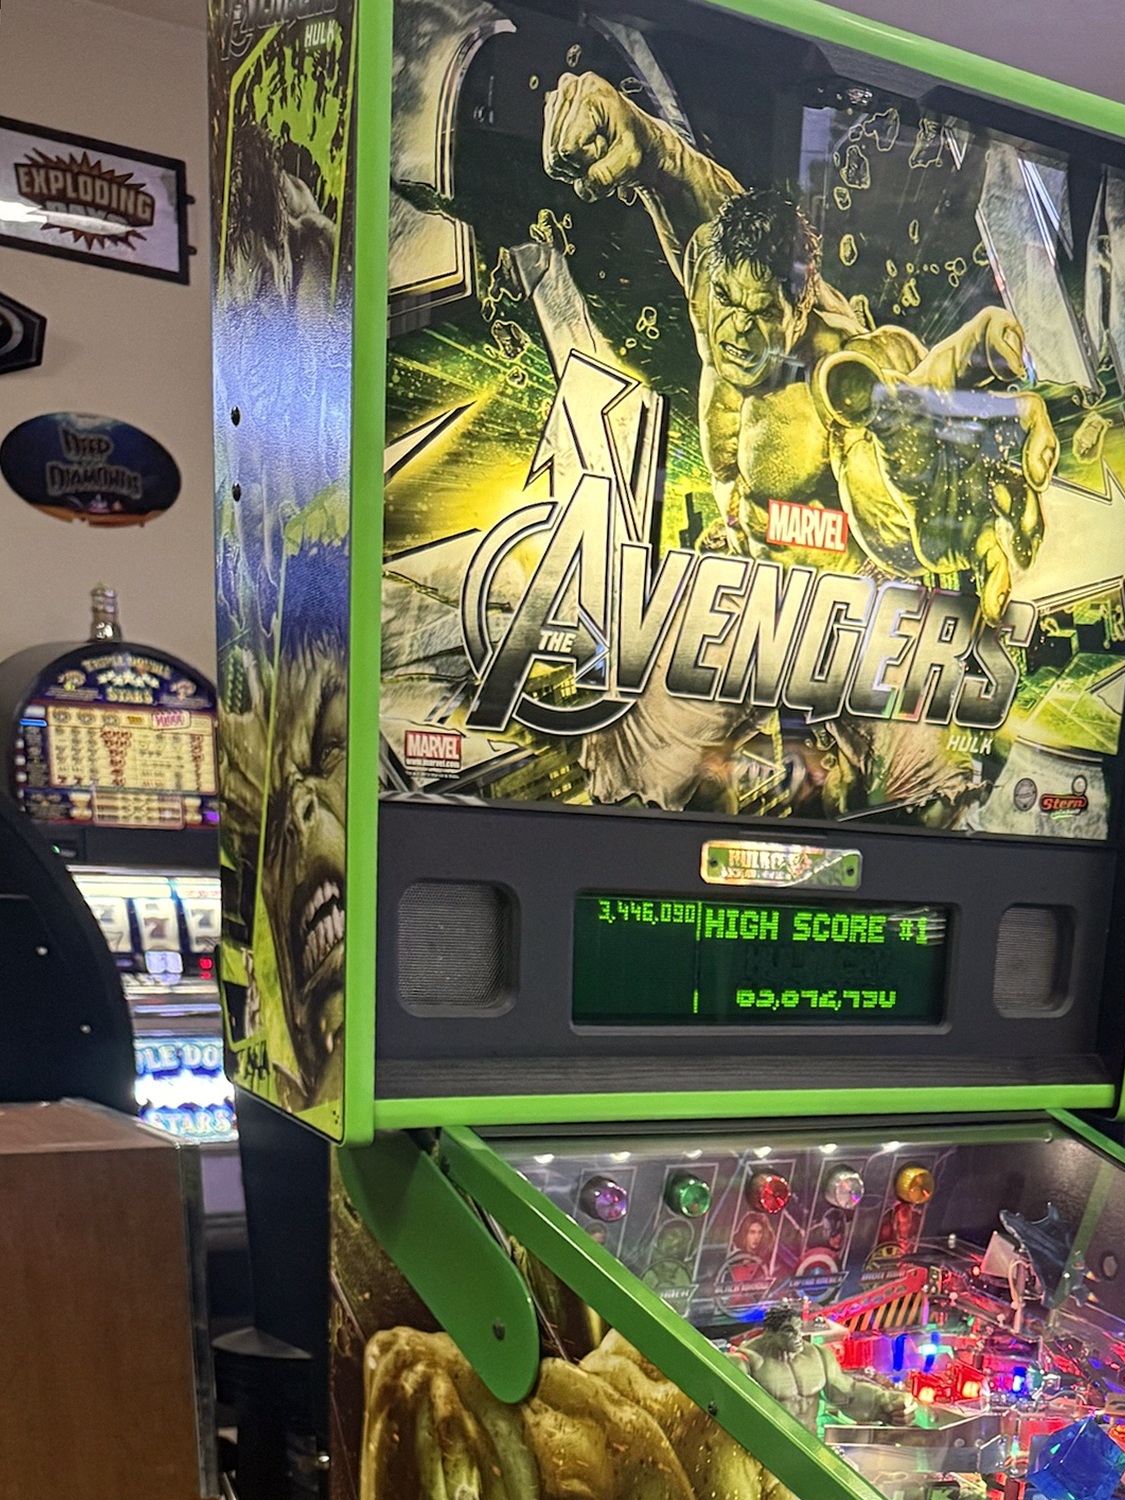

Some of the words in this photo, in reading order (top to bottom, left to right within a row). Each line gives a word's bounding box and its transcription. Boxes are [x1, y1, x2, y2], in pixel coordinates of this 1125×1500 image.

[304, 20, 337, 48] HULK
[19, 166, 153, 222] EXPLODING
[771, 506, 843, 549] MARVEL
[461, 476, 1036, 735] AVENGERS
[539, 629, 576, 655] THE
[406, 733, 460, 760] MARVEL
[946, 734, 993, 756] HULK
[1042, 797, 1085, 812] Stern
[599, 901, 696, 924] 3,446,090
[704, 909, 780, 941] HIGH
[792, 913, 888, 944] SCORE
[898, 916, 929, 946] #1
